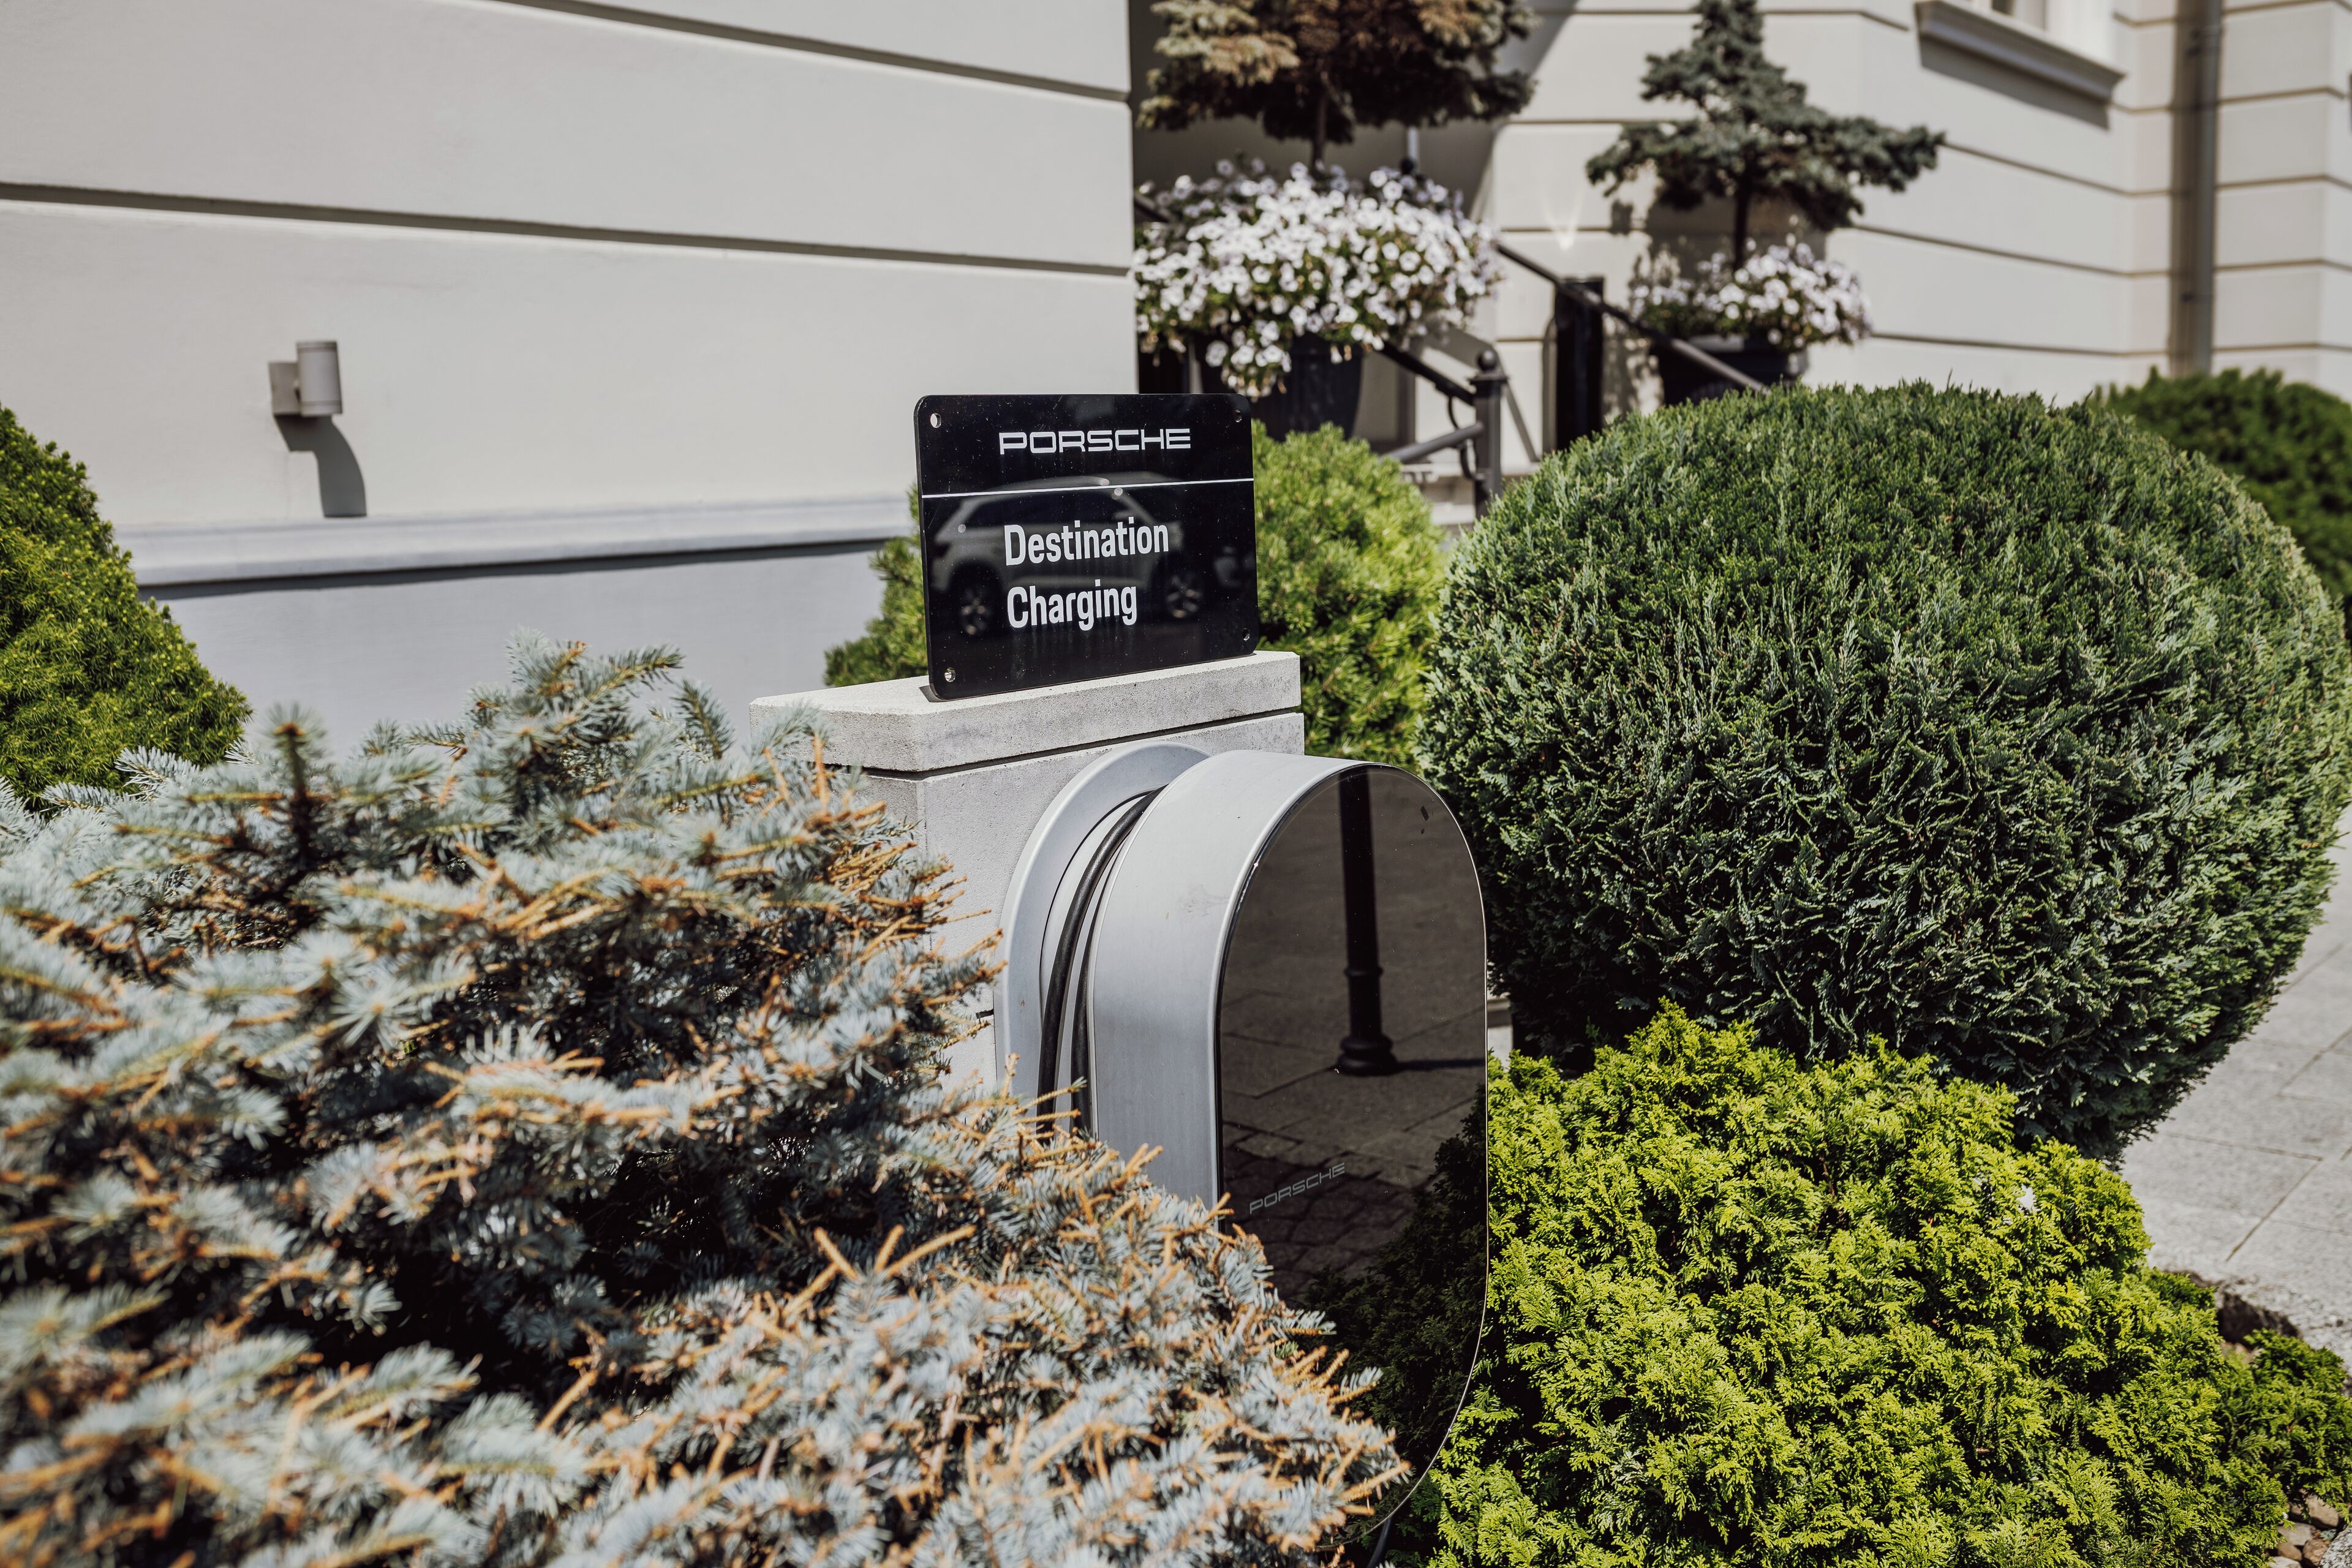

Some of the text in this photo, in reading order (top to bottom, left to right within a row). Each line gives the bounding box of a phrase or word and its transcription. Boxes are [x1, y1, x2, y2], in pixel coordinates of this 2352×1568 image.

[999, 428, 1191, 454] PORSCHE
[1004, 516, 1169, 566] Destination
[1008, 579, 1137, 631] Charging
[1250, 1162, 1345, 1215] PORSCHE
